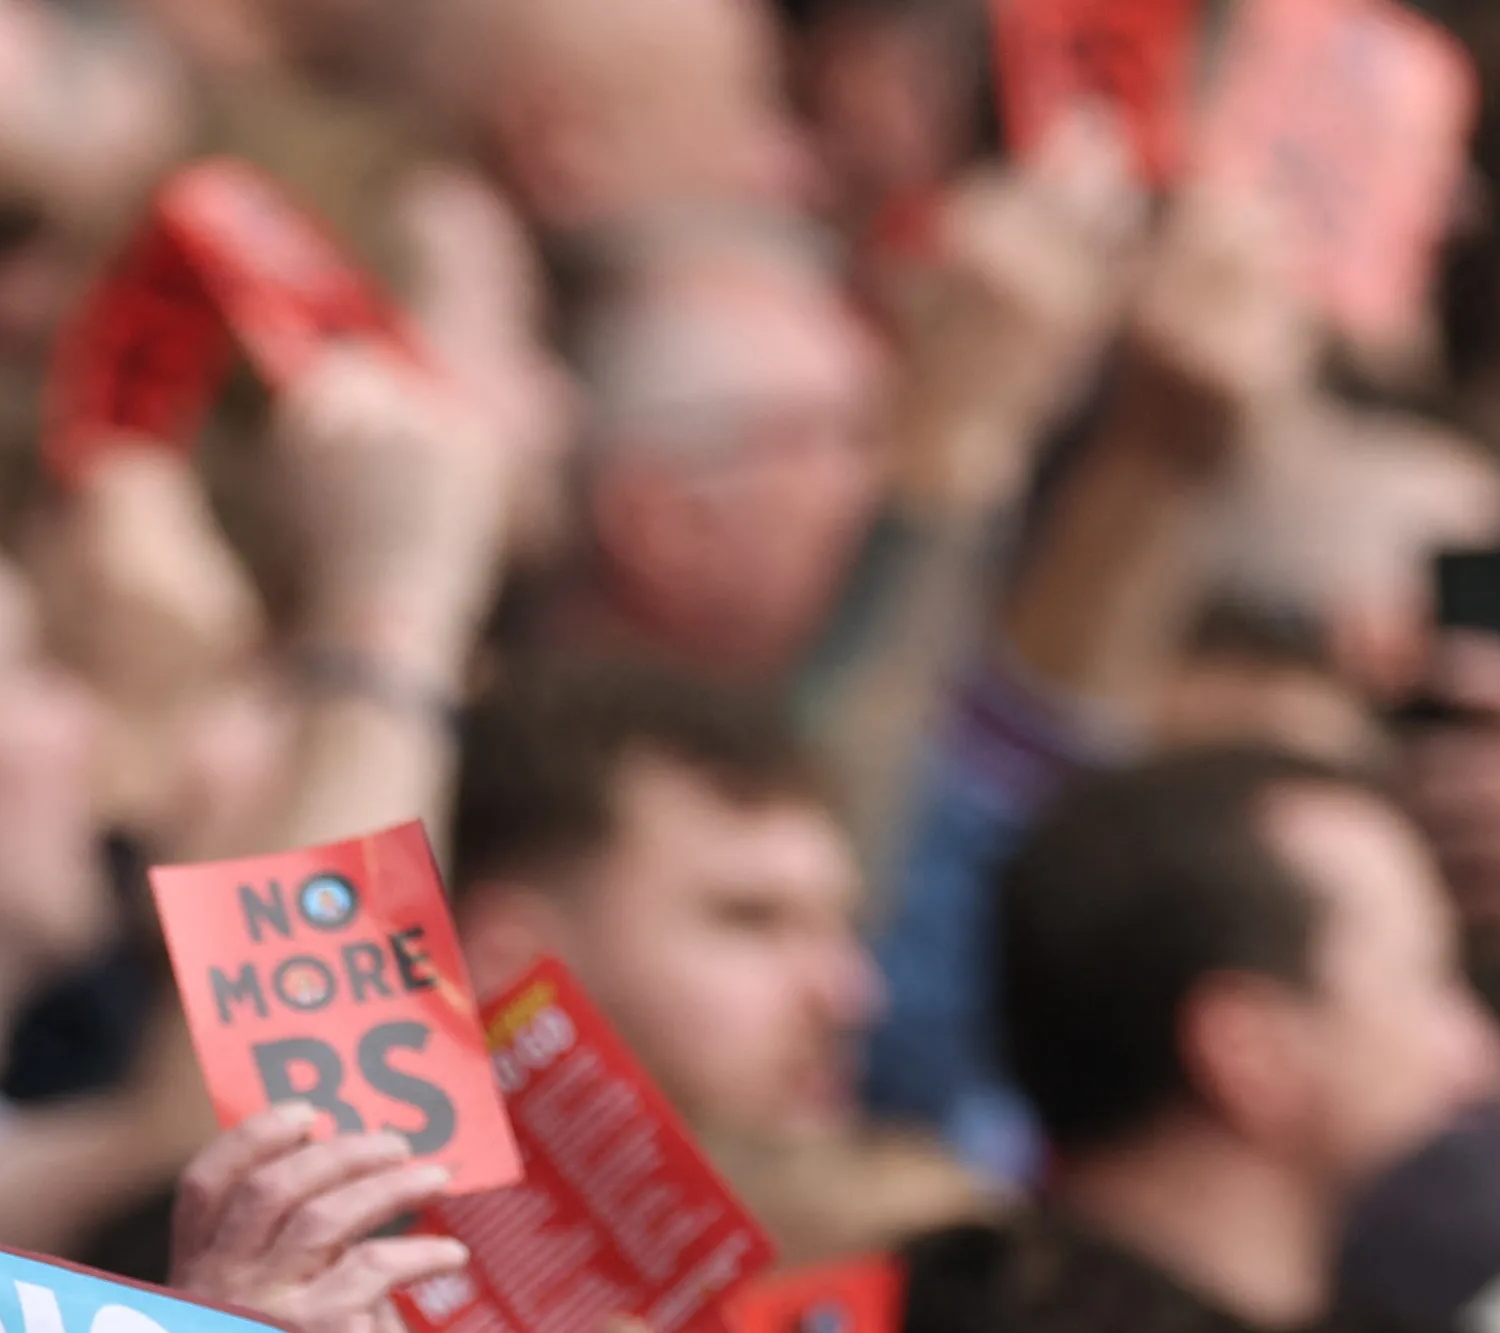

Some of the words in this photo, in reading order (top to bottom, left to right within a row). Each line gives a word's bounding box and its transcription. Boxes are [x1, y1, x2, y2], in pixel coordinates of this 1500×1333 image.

[236, 871, 359, 943] NO
[208, 928, 437, 1024] MORE
[249, 1021, 457, 1155] BS
